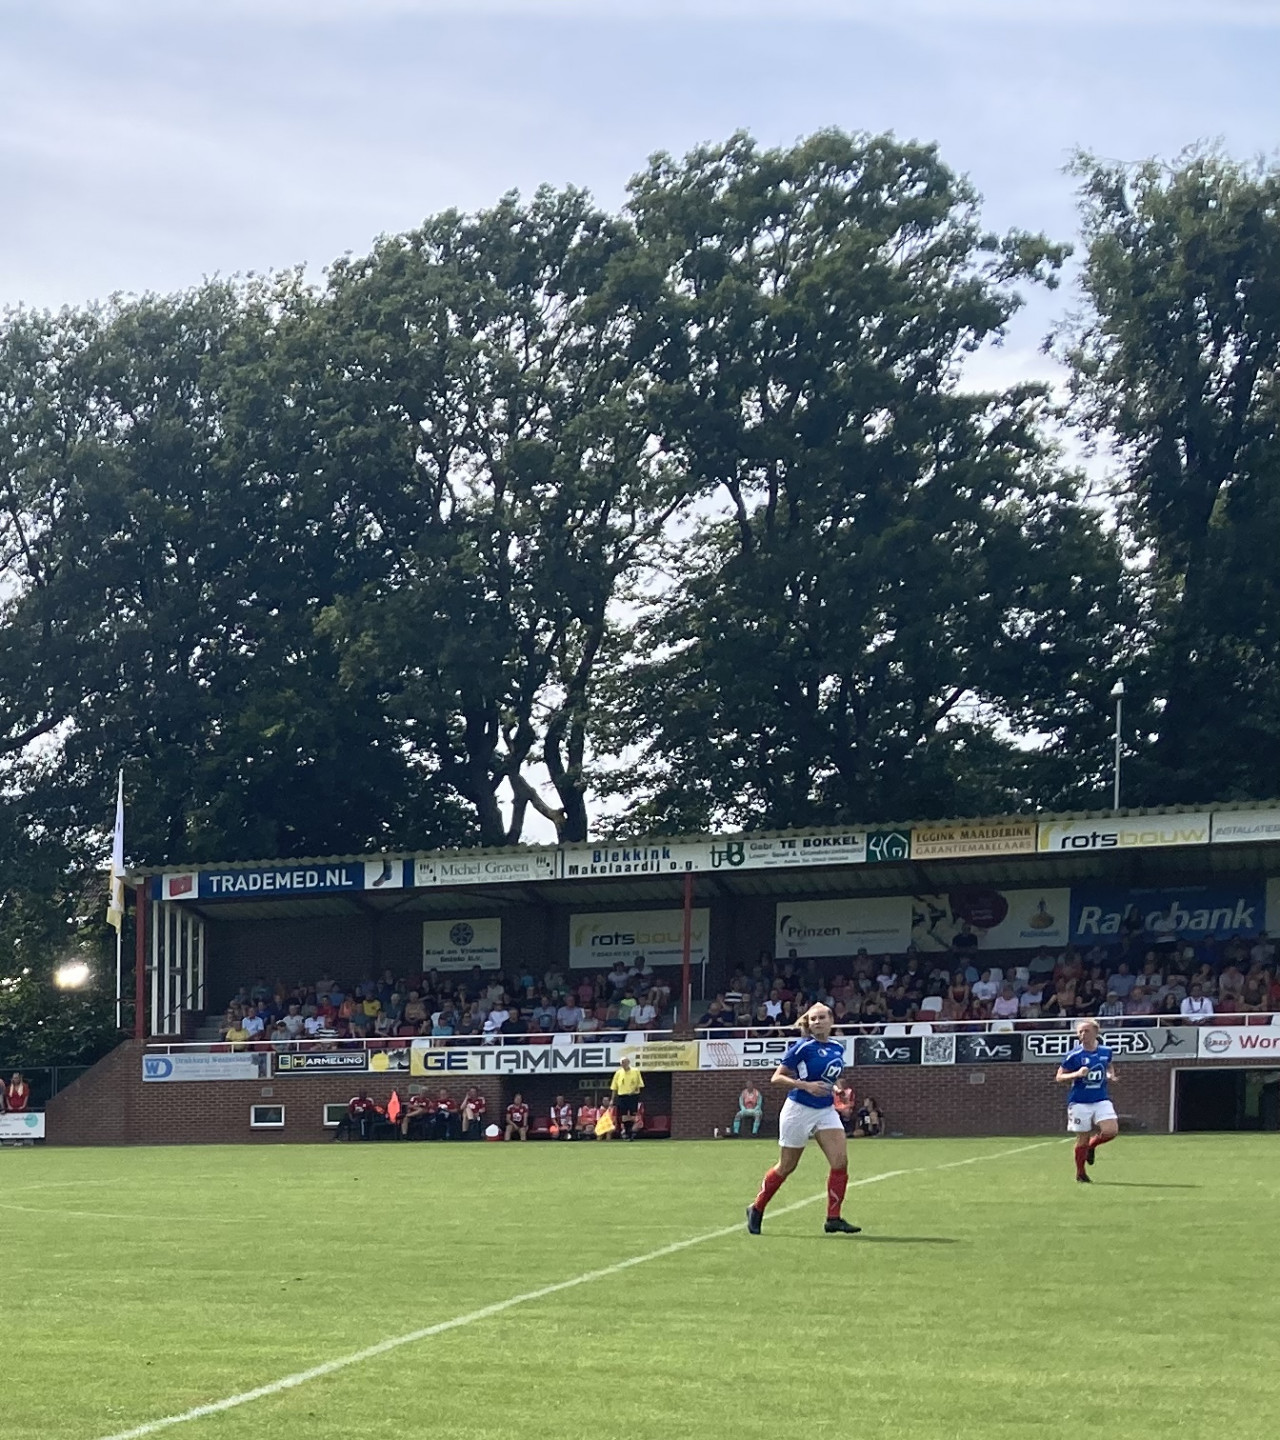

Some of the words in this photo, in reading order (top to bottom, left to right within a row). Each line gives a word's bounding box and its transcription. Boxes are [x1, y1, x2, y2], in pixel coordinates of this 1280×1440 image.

[780, 840, 797, 849] TE
[802, 836, 859, 848] BOKKEL
[1061, 828, 1206, 849] rotsbouw
[592, 846, 671, 863] Blekkink
[440, 863, 481, 877] Michel
[484, 861, 529, 873] Graven
[568, 860, 660, 876] Makelaardij
[209, 868, 353, 893] TRADEMED.NL
[788, 926, 840, 938] Prinzen
[743, 1041, 796, 1054] DS
[873, 1047, 910, 1059] TVS
[973, 1045, 1012, 1057] TVS
